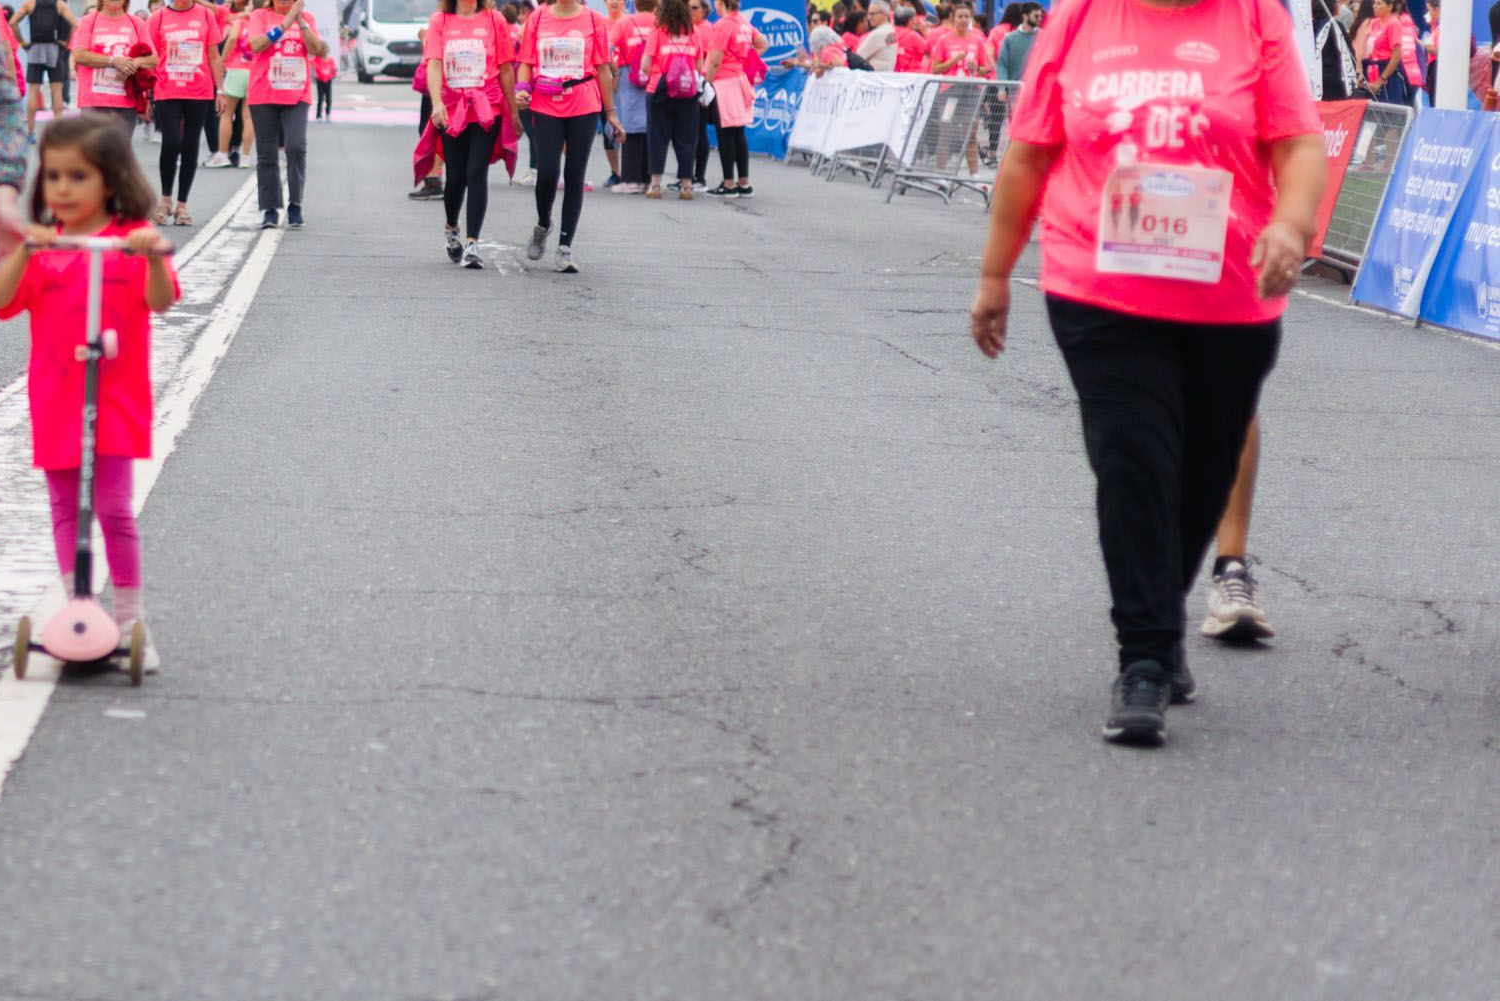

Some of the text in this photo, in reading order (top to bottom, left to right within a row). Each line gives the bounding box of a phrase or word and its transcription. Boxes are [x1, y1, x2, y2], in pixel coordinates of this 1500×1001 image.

[554, 54, 571, 62] 016
[1089, 70, 1205, 102] CARRERA
[1146, 105, 1190, 148] DE
[1141, 214, 1189, 236] 016
